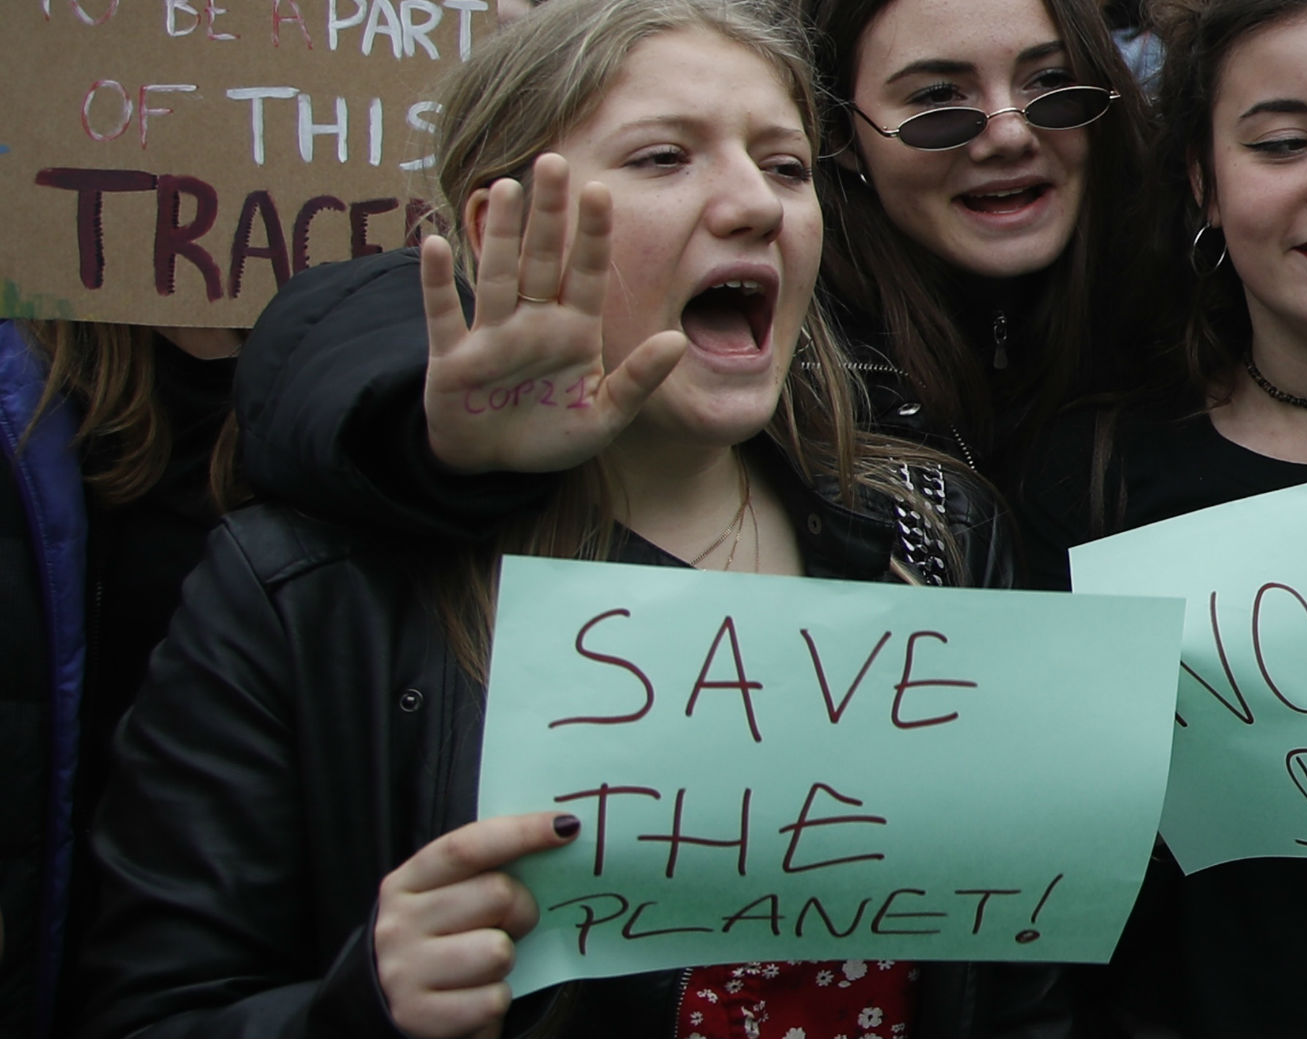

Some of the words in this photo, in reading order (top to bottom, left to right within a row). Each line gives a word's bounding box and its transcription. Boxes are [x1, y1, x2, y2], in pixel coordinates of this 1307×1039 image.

[81, 79, 199, 150] OF
[225, 86, 444, 170] THIS
[548, 608, 979, 743] SAVE
[553, 782, 887, 879] THE
[547, 872, 1064, 956] PLANET!
